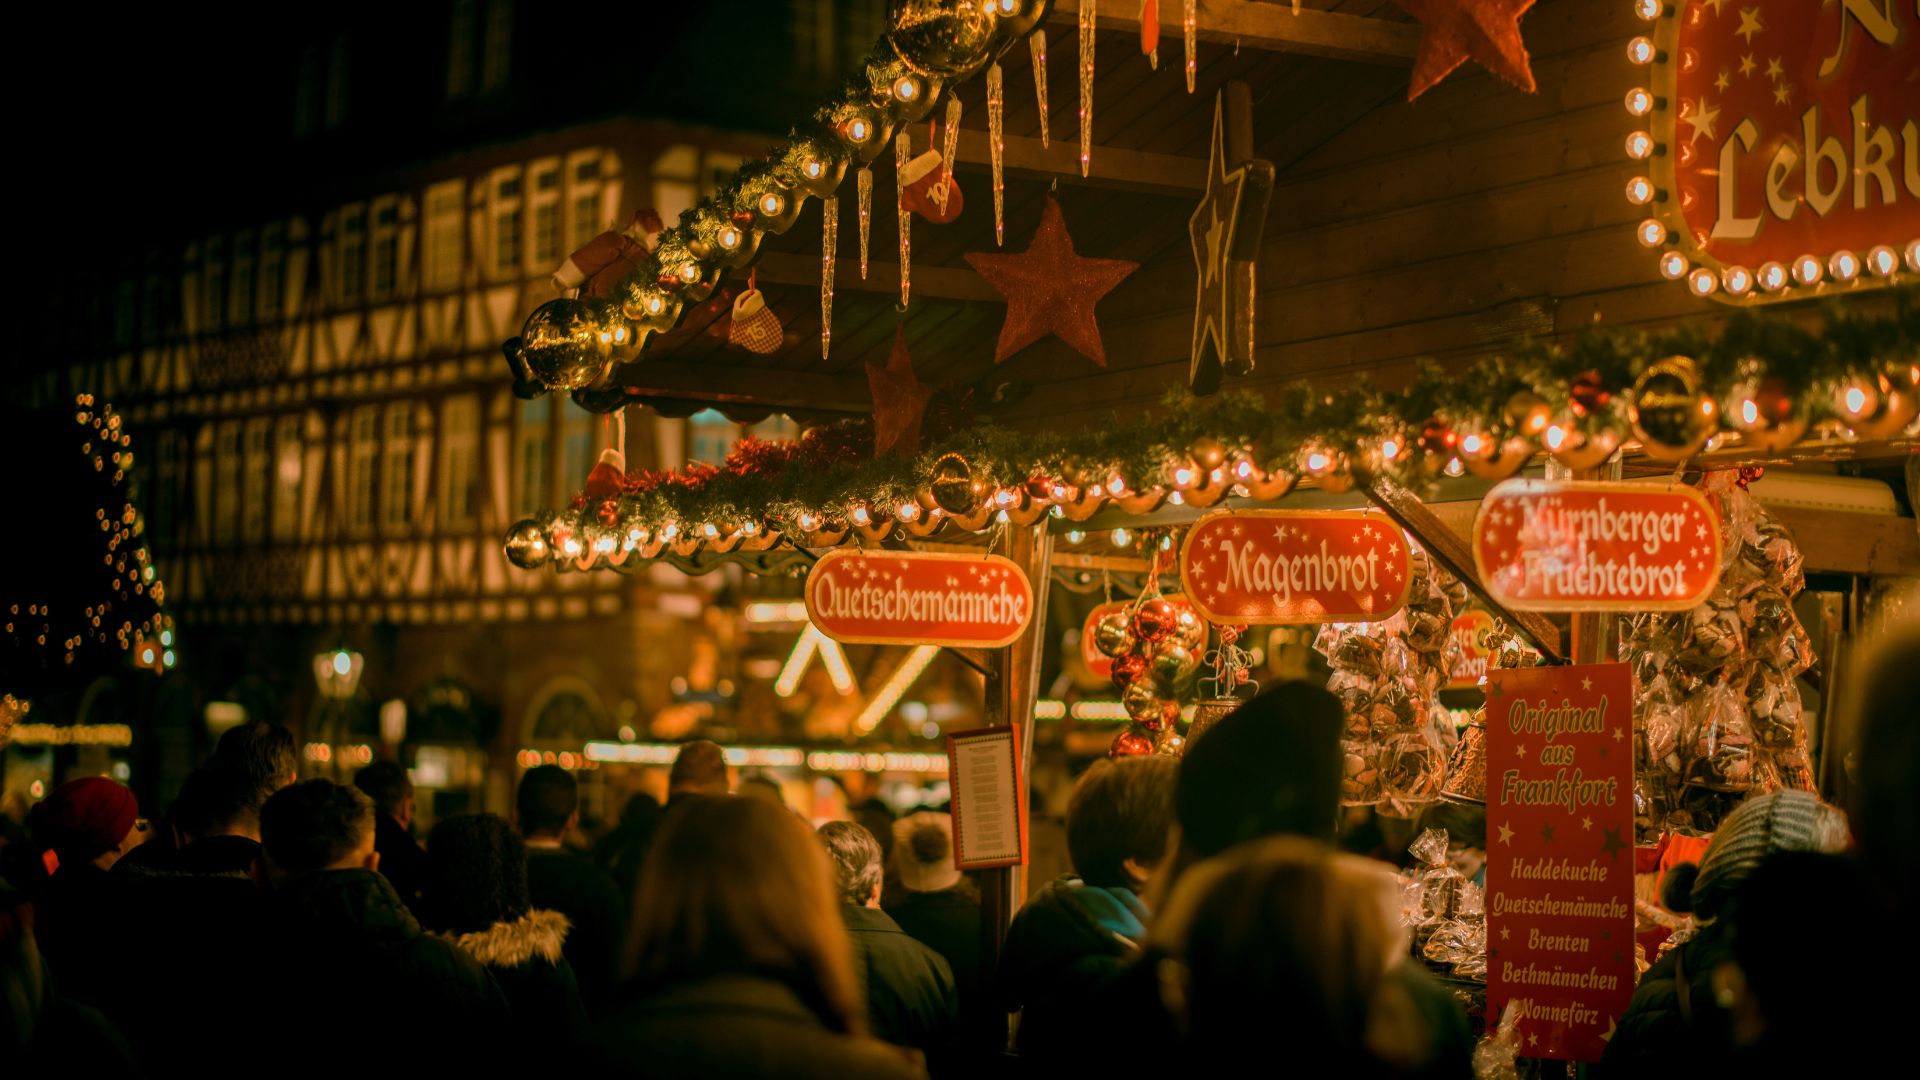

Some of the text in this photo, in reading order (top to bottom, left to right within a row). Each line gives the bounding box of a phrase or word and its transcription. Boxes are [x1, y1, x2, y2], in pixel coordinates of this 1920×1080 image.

[745, 321, 767, 342] 15
[1516, 496, 1686, 555] Nürnberger
[1216, 539, 1379, 608] Magenbrot
[814, 571, 1025, 625] Quetschemännche
[1508, 694, 1608, 743] Original
[1540, 744, 1576, 766] aus
[1500, 767, 1618, 815] Frankfort
[1510, 857, 1608, 882] Haddekuche
[1492, 891, 1628, 919] Quetschemännche
[1527, 927, 1590, 953] Brenten
[1501, 961, 1618, 991] Bethmännchen
[1521, 997, 1599, 1029] Nonneförz
